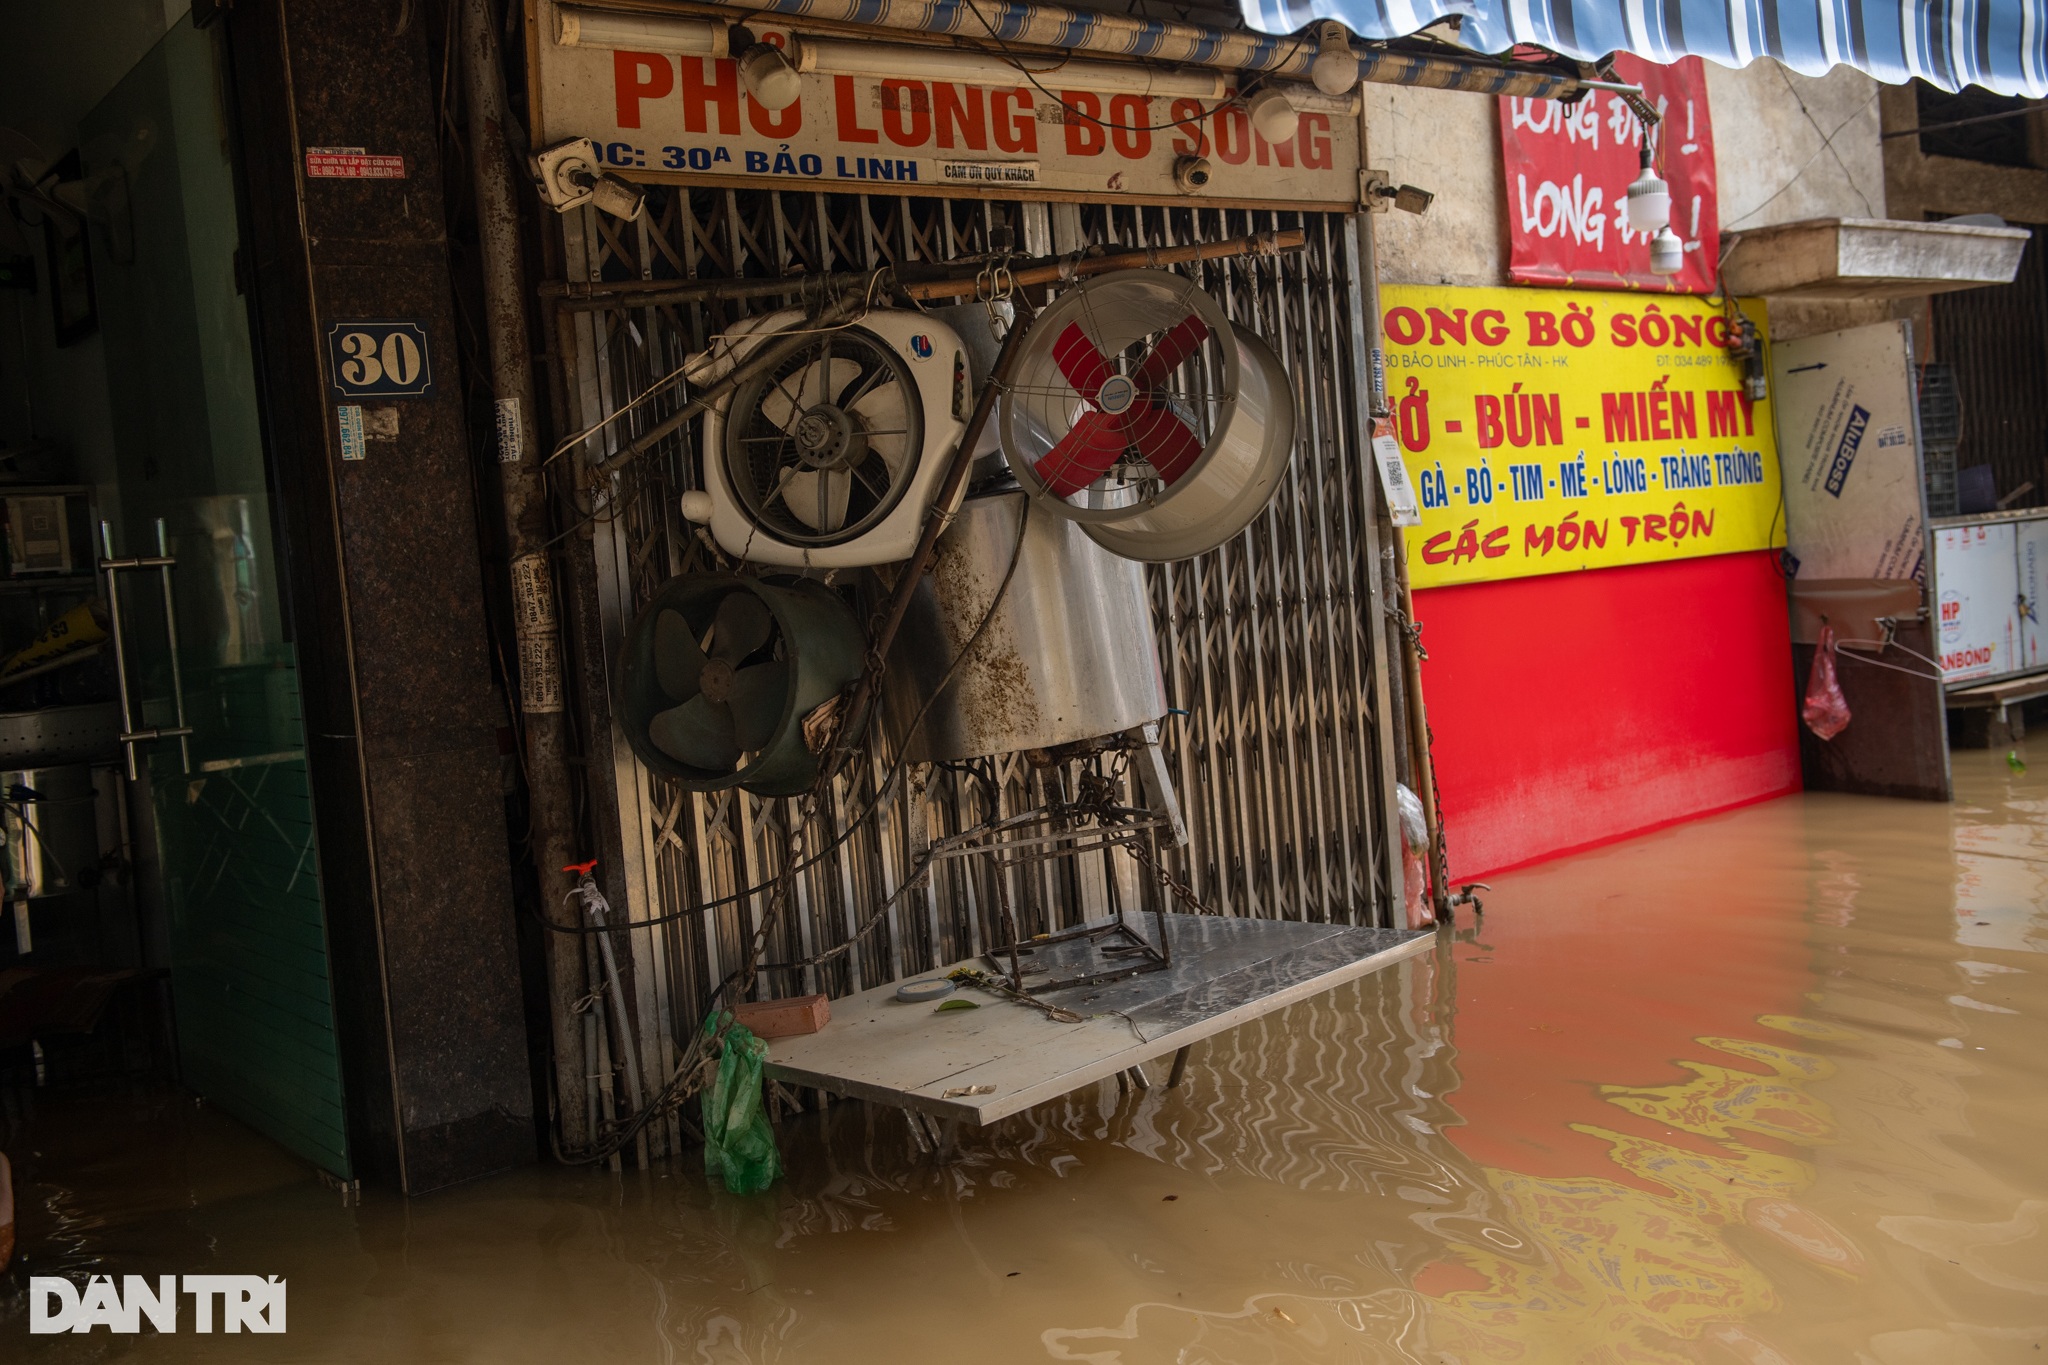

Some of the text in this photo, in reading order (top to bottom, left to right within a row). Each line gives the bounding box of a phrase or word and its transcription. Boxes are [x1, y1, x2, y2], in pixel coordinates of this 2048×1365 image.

[834, 75, 1038, 153] LONG
[1510, 88, 1599, 150] LONG
[745, 144, 823, 176] BẢO
[836, 156, 919, 181] LINH
[984, 164, 1002, 181] QUÝ
[1005, 166, 1035, 181] KHÁCH
[1517, 173, 1606, 252] LONG
[1384, 302, 1730, 348] ONG BỜ SÔNG
[341, 332, 420, 386] 30
[1402, 351, 1433, 368] BẢO
[1437, 355, 1467, 368] LINH
[1478, 352, 1514, 368] PHÚC
[1518, 353, 1542, 368] TÂN
[1552, 356, 1569, 368] HK
[1474, 382, 1564, 449] BÚN
[1602, 375, 1698, 444] MIẾN
[1420, 461, 1448, 508] GÀ
[1466, 458, 1492, 504] BÒ
[1509, 464, 1544, 501] TIM
[1560, 450, 1587, 497] MỀ
[1603, 451, 1646, 494] LÒNG
[1660, 448, 1712, 489] TRÀNG
[1714, 445, 1763, 485] TRỨNG
[1827, 410, 1867, 495] AluBoss
[1421, 501, 1715, 566] CÁC MÓN TRỘN
[1942, 601, 1959, 622] HP
